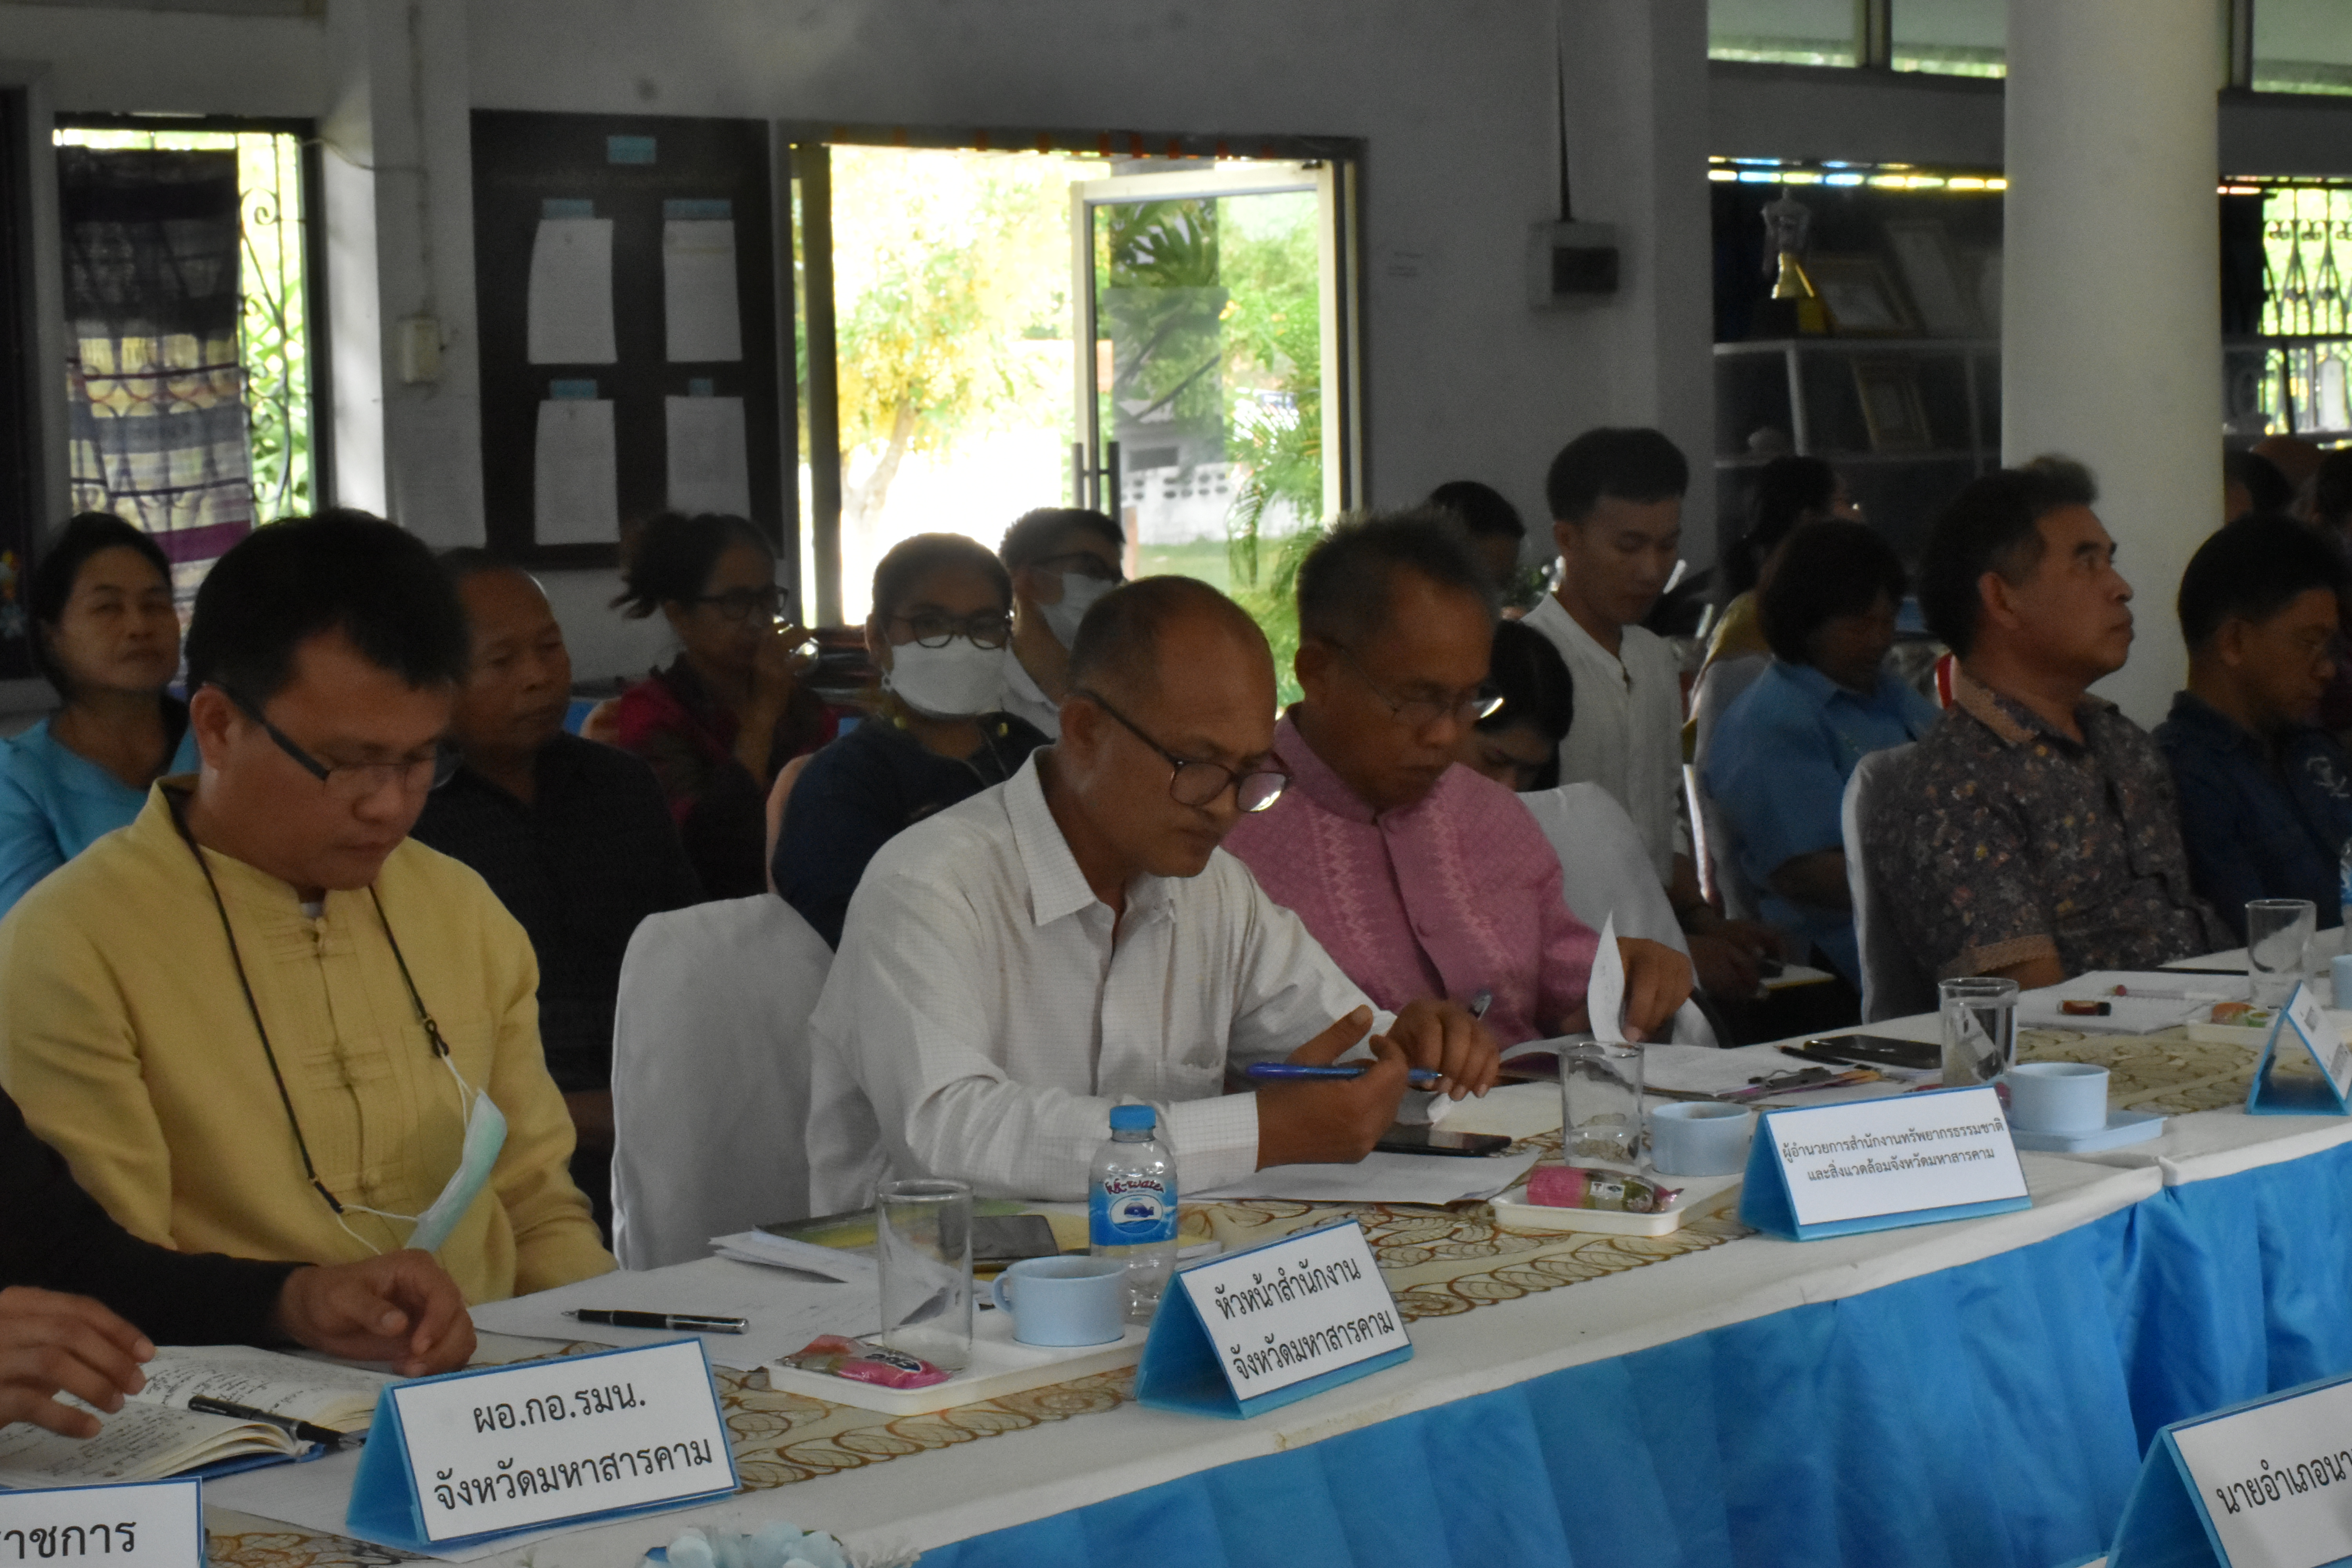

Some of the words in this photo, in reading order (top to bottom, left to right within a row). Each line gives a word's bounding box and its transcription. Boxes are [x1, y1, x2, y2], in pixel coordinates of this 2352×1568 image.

[1782, 1117, 2004, 1163] ผู้อำนวยการสำนักงานทรัพยากรธรรมชาติ
[1808, 1149, 1994, 1181] และสิ่งแวดล้อมจังหวัดมหาสารคาม
[1215, 1258, 1361, 1319] หัวหน้าสำนักงาน
[1230, 1310, 1394, 1379] จังหวัดมหาสารคาม
[474, 1383, 646, 1433] ผอ.กอ.รมน.
[434, 1439, 712, 1510] จังหวัดมหาสารคาม
[2216, 1448, 2352, 1514] นายอำเภอนา
[0, 1522, 136, 1559] าชการ
